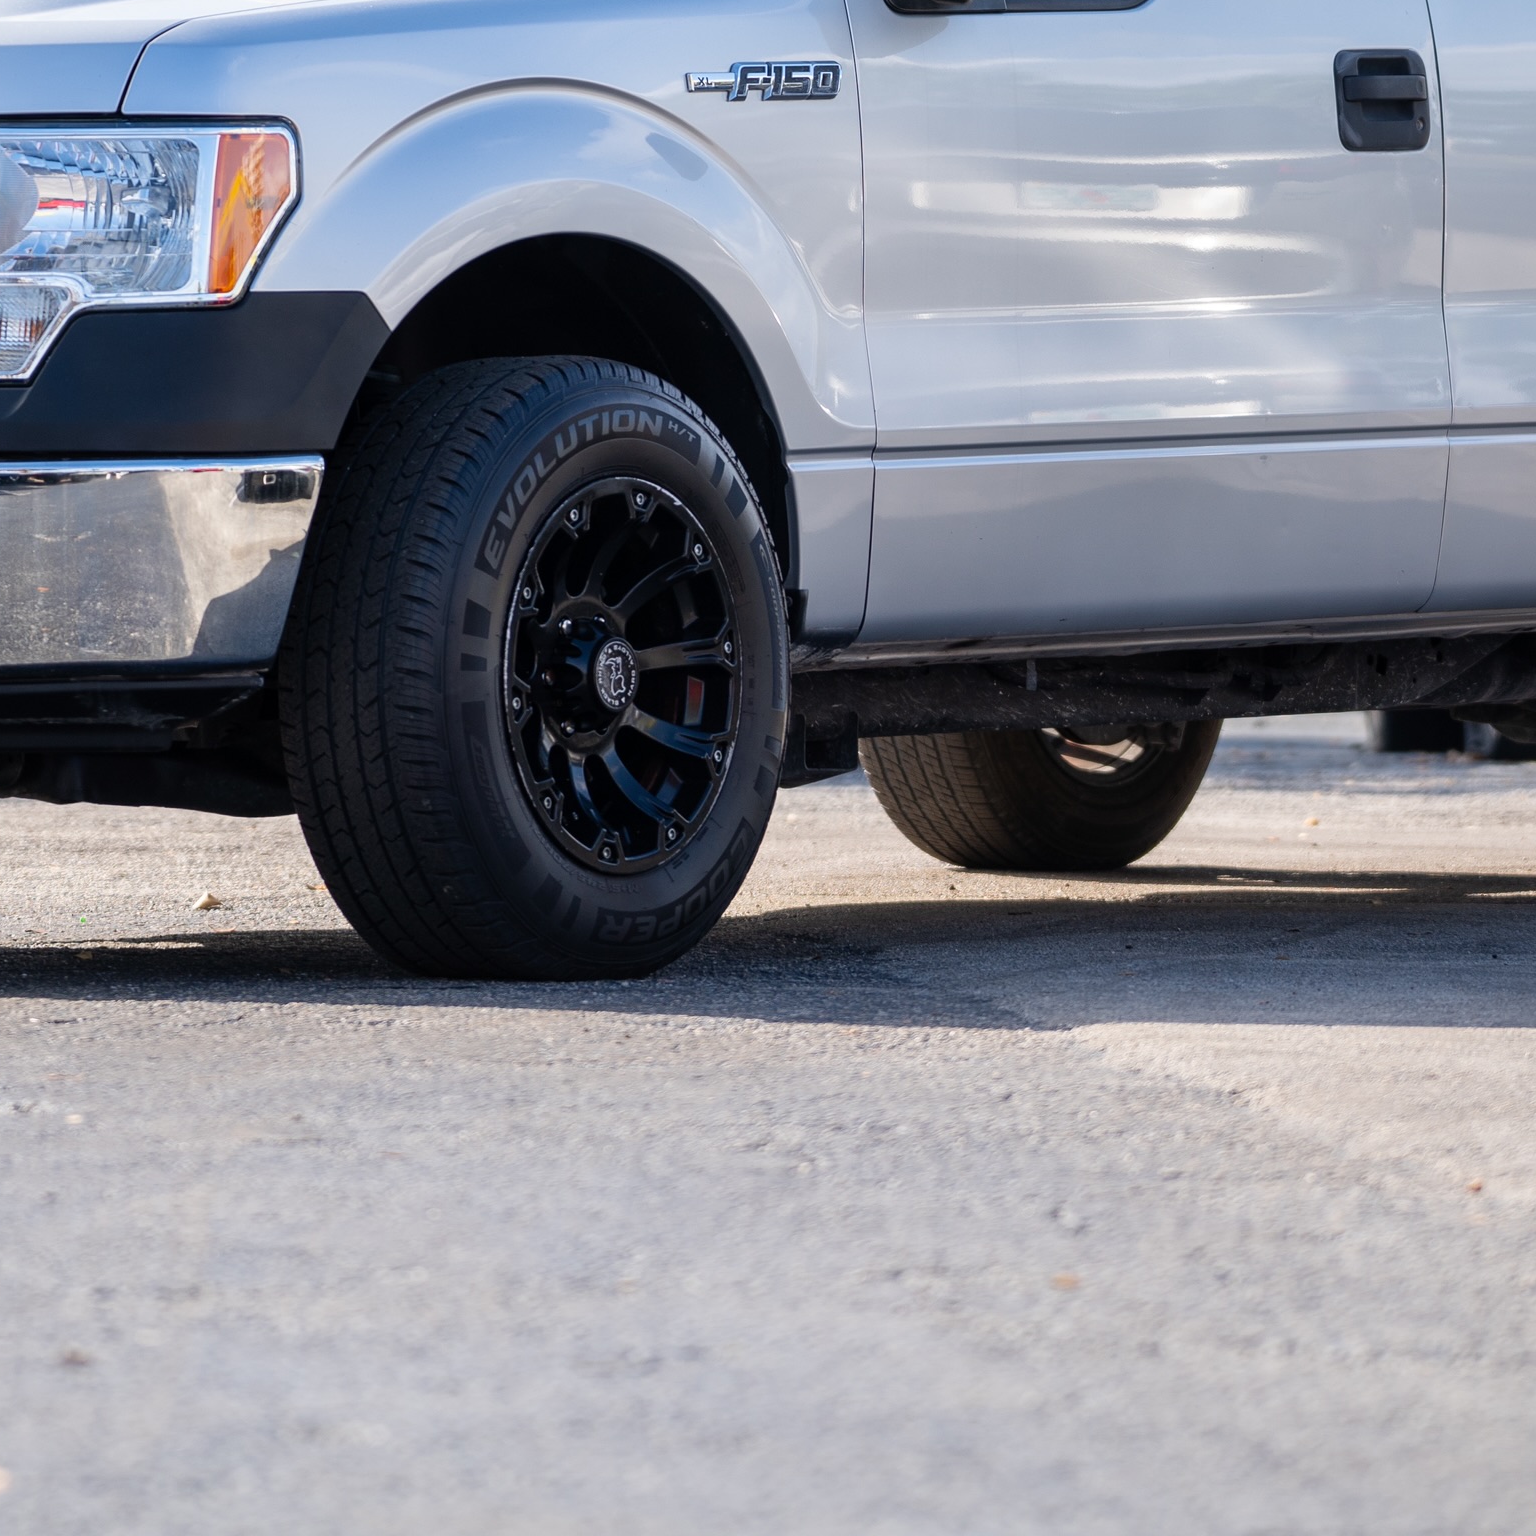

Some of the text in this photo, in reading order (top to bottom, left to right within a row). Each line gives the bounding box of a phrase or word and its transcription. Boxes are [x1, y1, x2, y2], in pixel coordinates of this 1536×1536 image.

[697, 76, 714, 86] XL
[484, 409, 663, 570] EVOLUTION
[668, 421, 696, 443] H/T
[598, 831, 751, 943] COOPER
